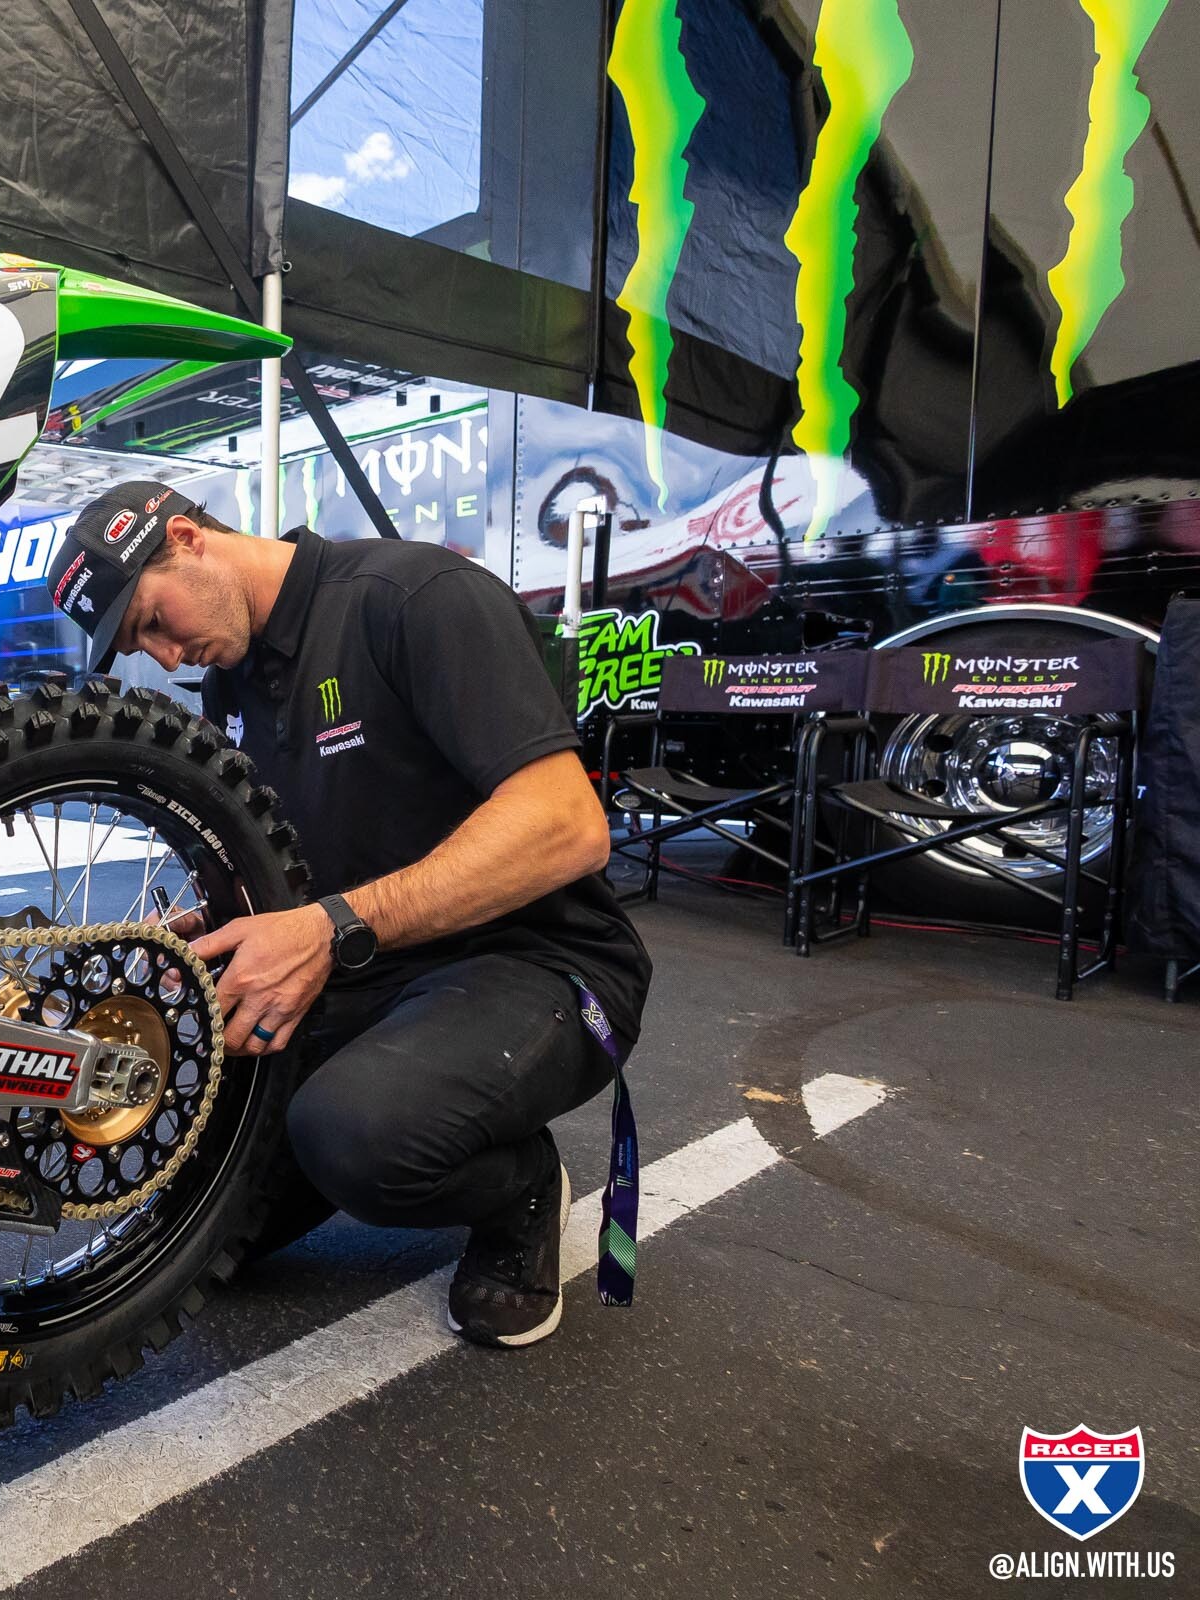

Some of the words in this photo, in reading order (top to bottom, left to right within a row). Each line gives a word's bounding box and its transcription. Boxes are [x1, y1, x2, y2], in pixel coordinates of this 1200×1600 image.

[7, 275, 49, 292] SMX
[108, 513, 133, 540] BELL
[119, 515, 159, 564] DUNLOP
[728, 660, 818, 677] MONSTER
[954, 655, 1080, 674] MONSTER
[577, 645, 694, 714] GREE
[971, 674, 1059, 683] ENERGY
[951, 683, 998, 695] PRO
[995, 682, 1078, 695] CIRCUIT
[729, 694, 806, 707] Kawasaki
[958, 694, 1063, 708] Kawasaki
[319, 733, 365, 757] Kawasaki
[166, 799, 203, 831] EXCEL
[200, 828, 223, 850] A60
